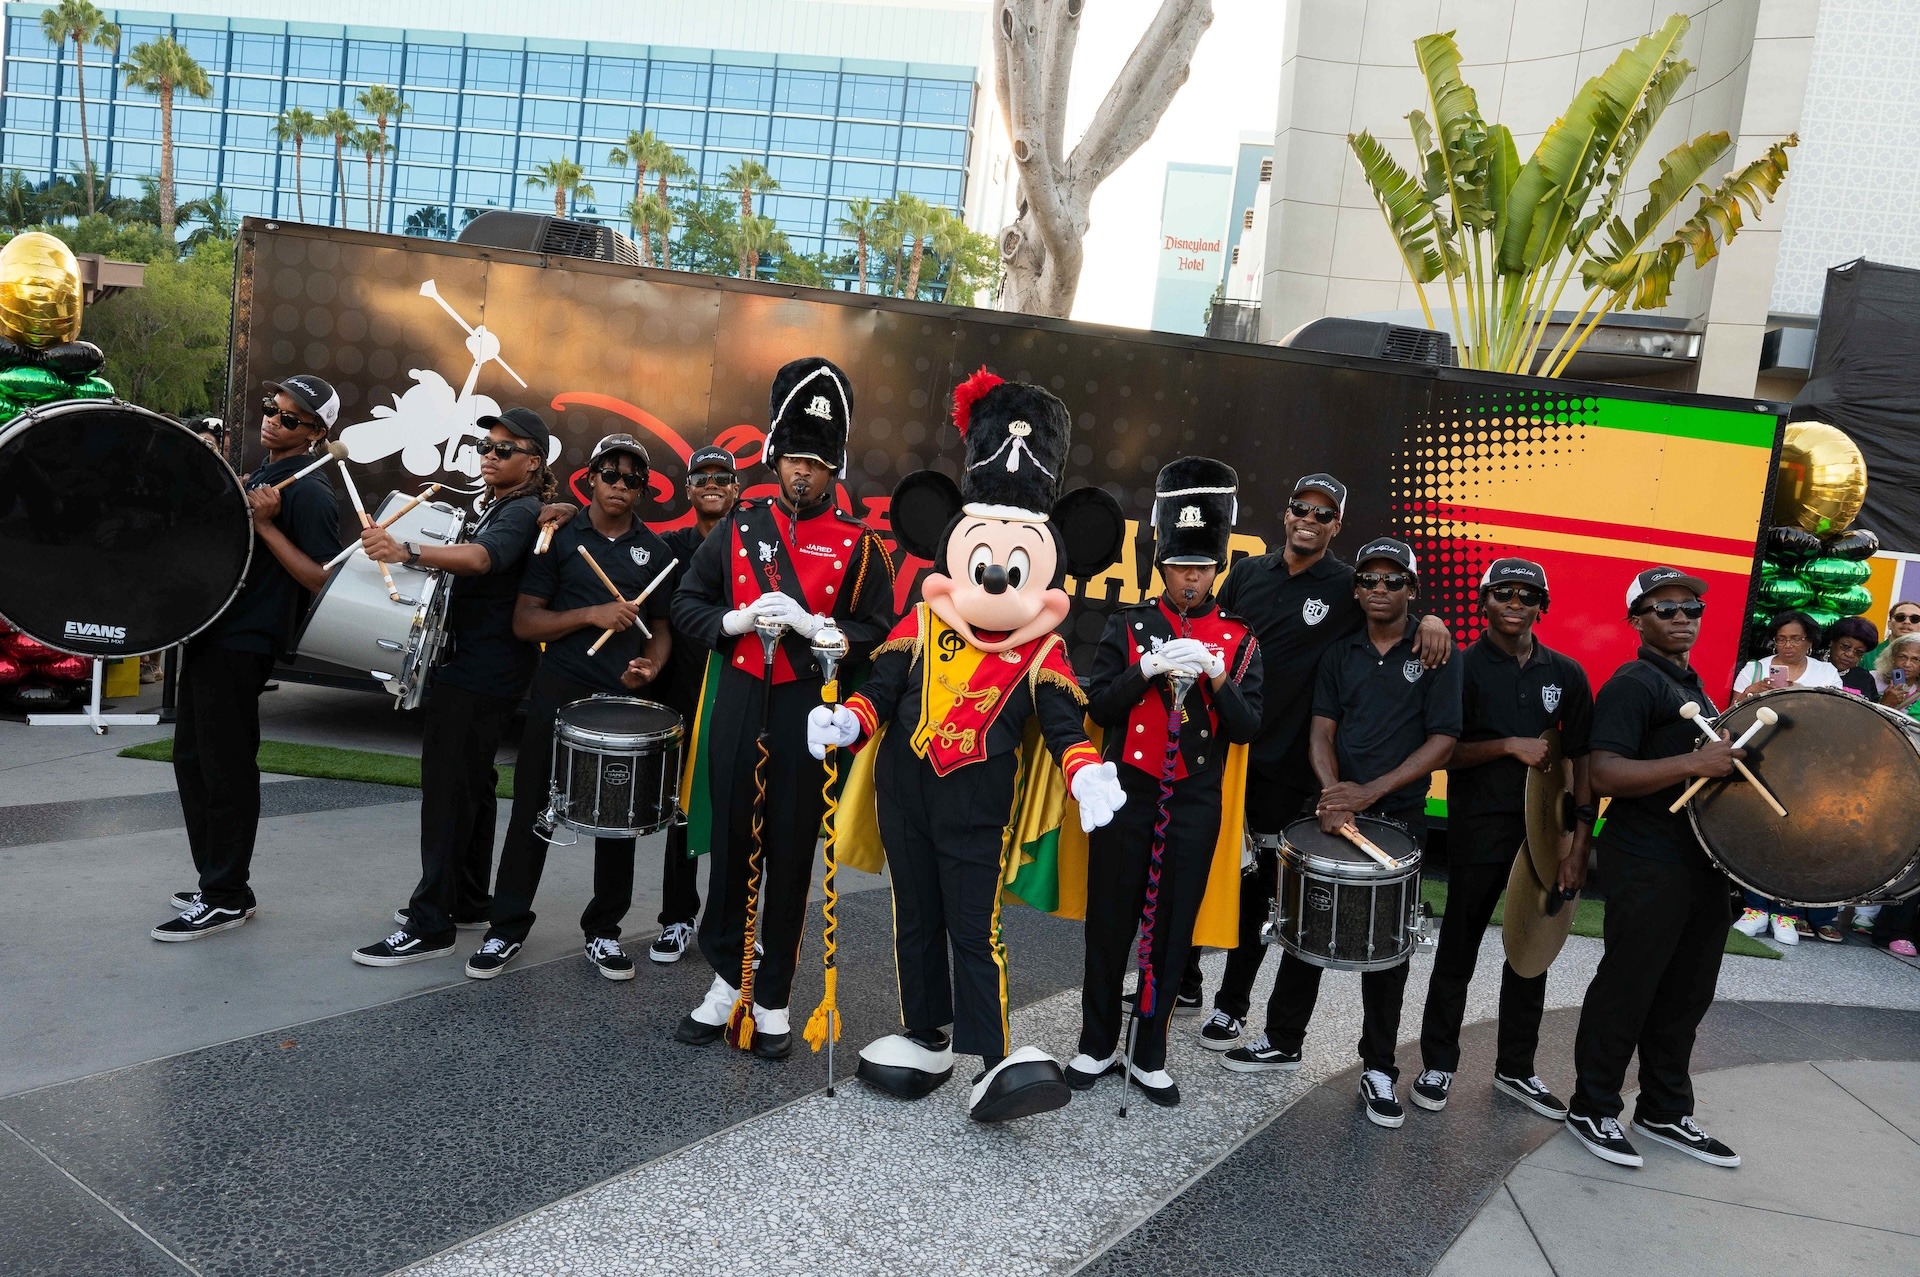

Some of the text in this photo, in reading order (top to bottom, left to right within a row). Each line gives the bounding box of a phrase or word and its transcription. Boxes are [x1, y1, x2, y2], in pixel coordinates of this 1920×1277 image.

[1164, 235, 1221, 253] Disneyland
[1178, 256, 1205, 271] Hotel
[806, 543, 833, 553] JARED
[1306, 602, 1325, 617] BU
[64, 620, 127, 639] EVANS
[1406, 663, 1422, 675] BU
[1545, 690, 1561, 703] BU
